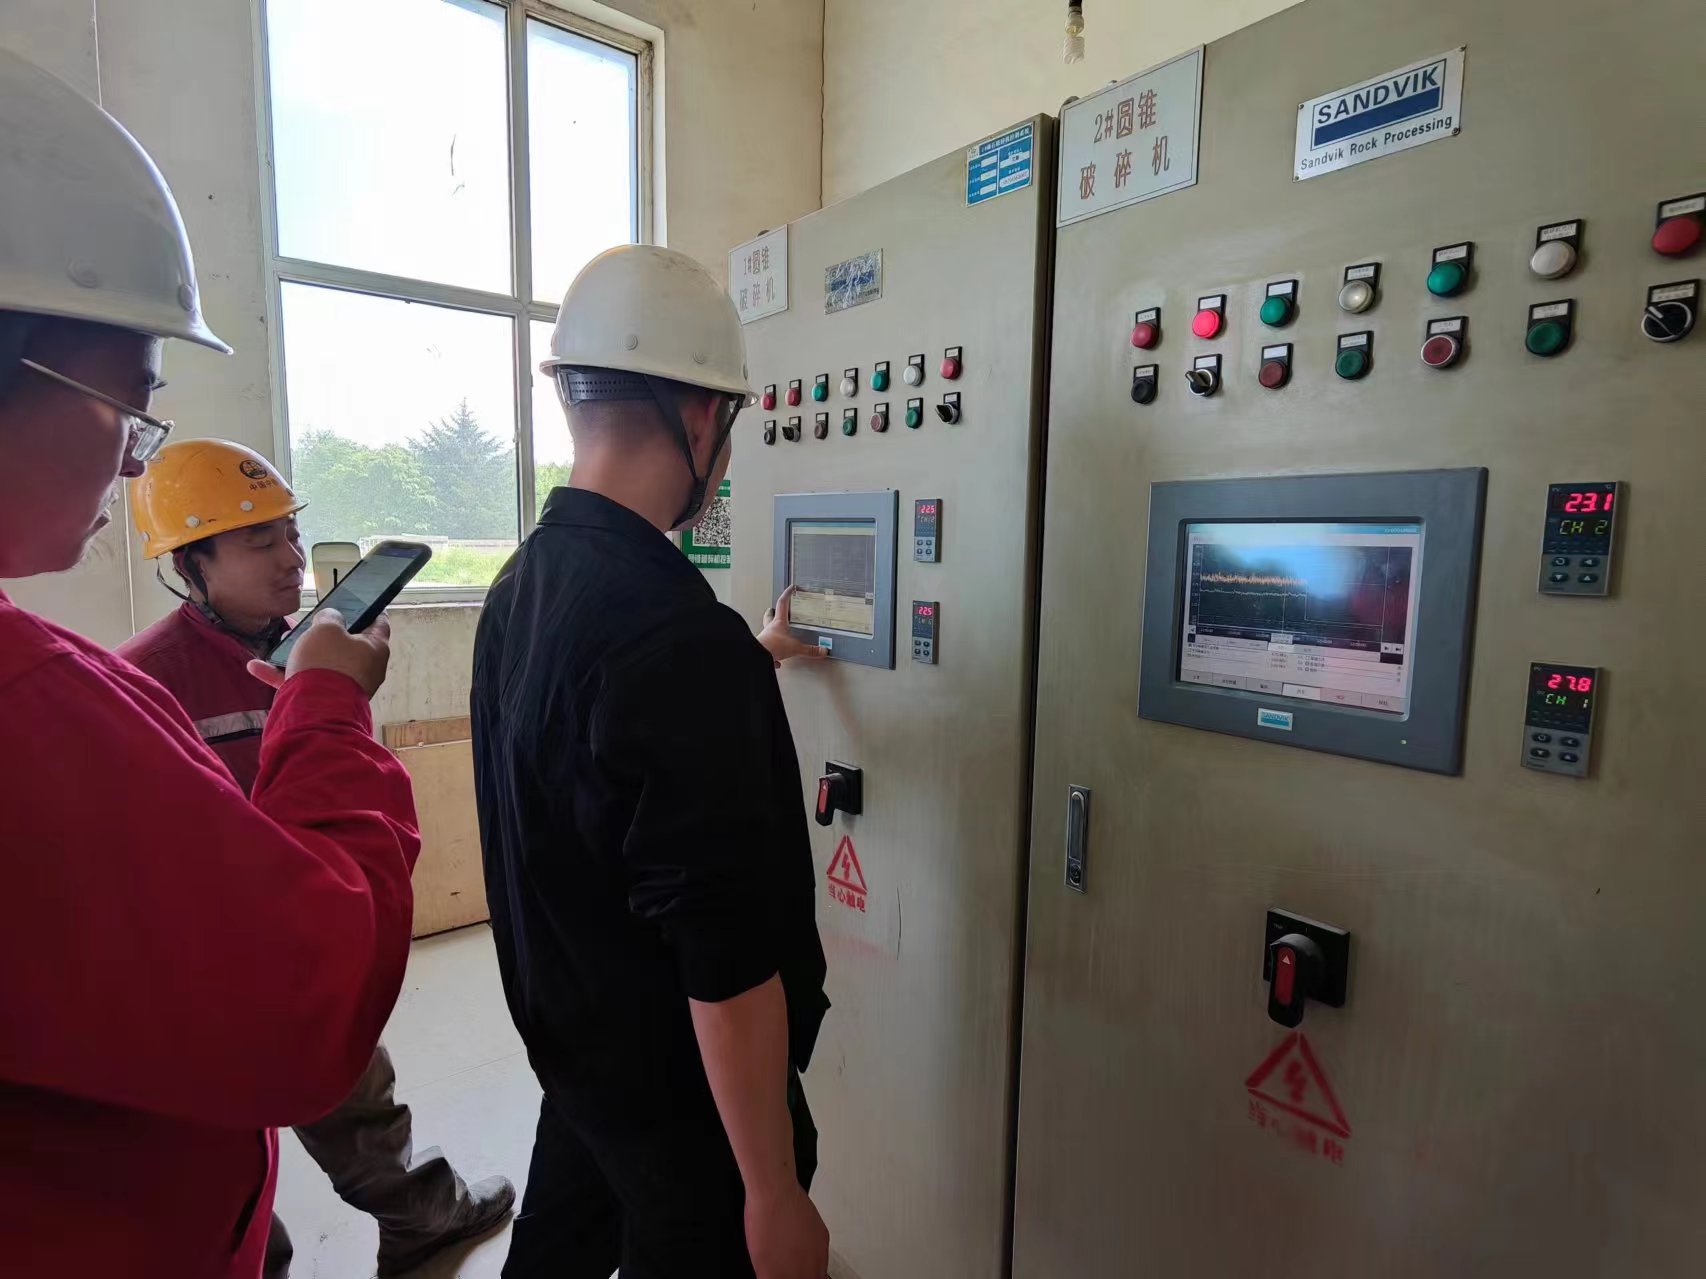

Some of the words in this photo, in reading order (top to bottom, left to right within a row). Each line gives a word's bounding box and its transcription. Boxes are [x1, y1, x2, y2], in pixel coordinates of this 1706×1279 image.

[1093, 89, 1158, 143] 2#圆锥
[1317, 66, 1440, 125] SANDVIK
[1079, 135, 1171, 200] 破碎机
[1300, 146, 1345, 171] Sandvik
[1350, 137, 1378, 156] Rock
[1384, 115, 1453, 145] Processing
[1559, 519, 1584, 535] CH
[1594, 519, 1609, 535] 2
[1545, 693, 1567, 705] CH
[1583, 698, 1589, 708] 1
